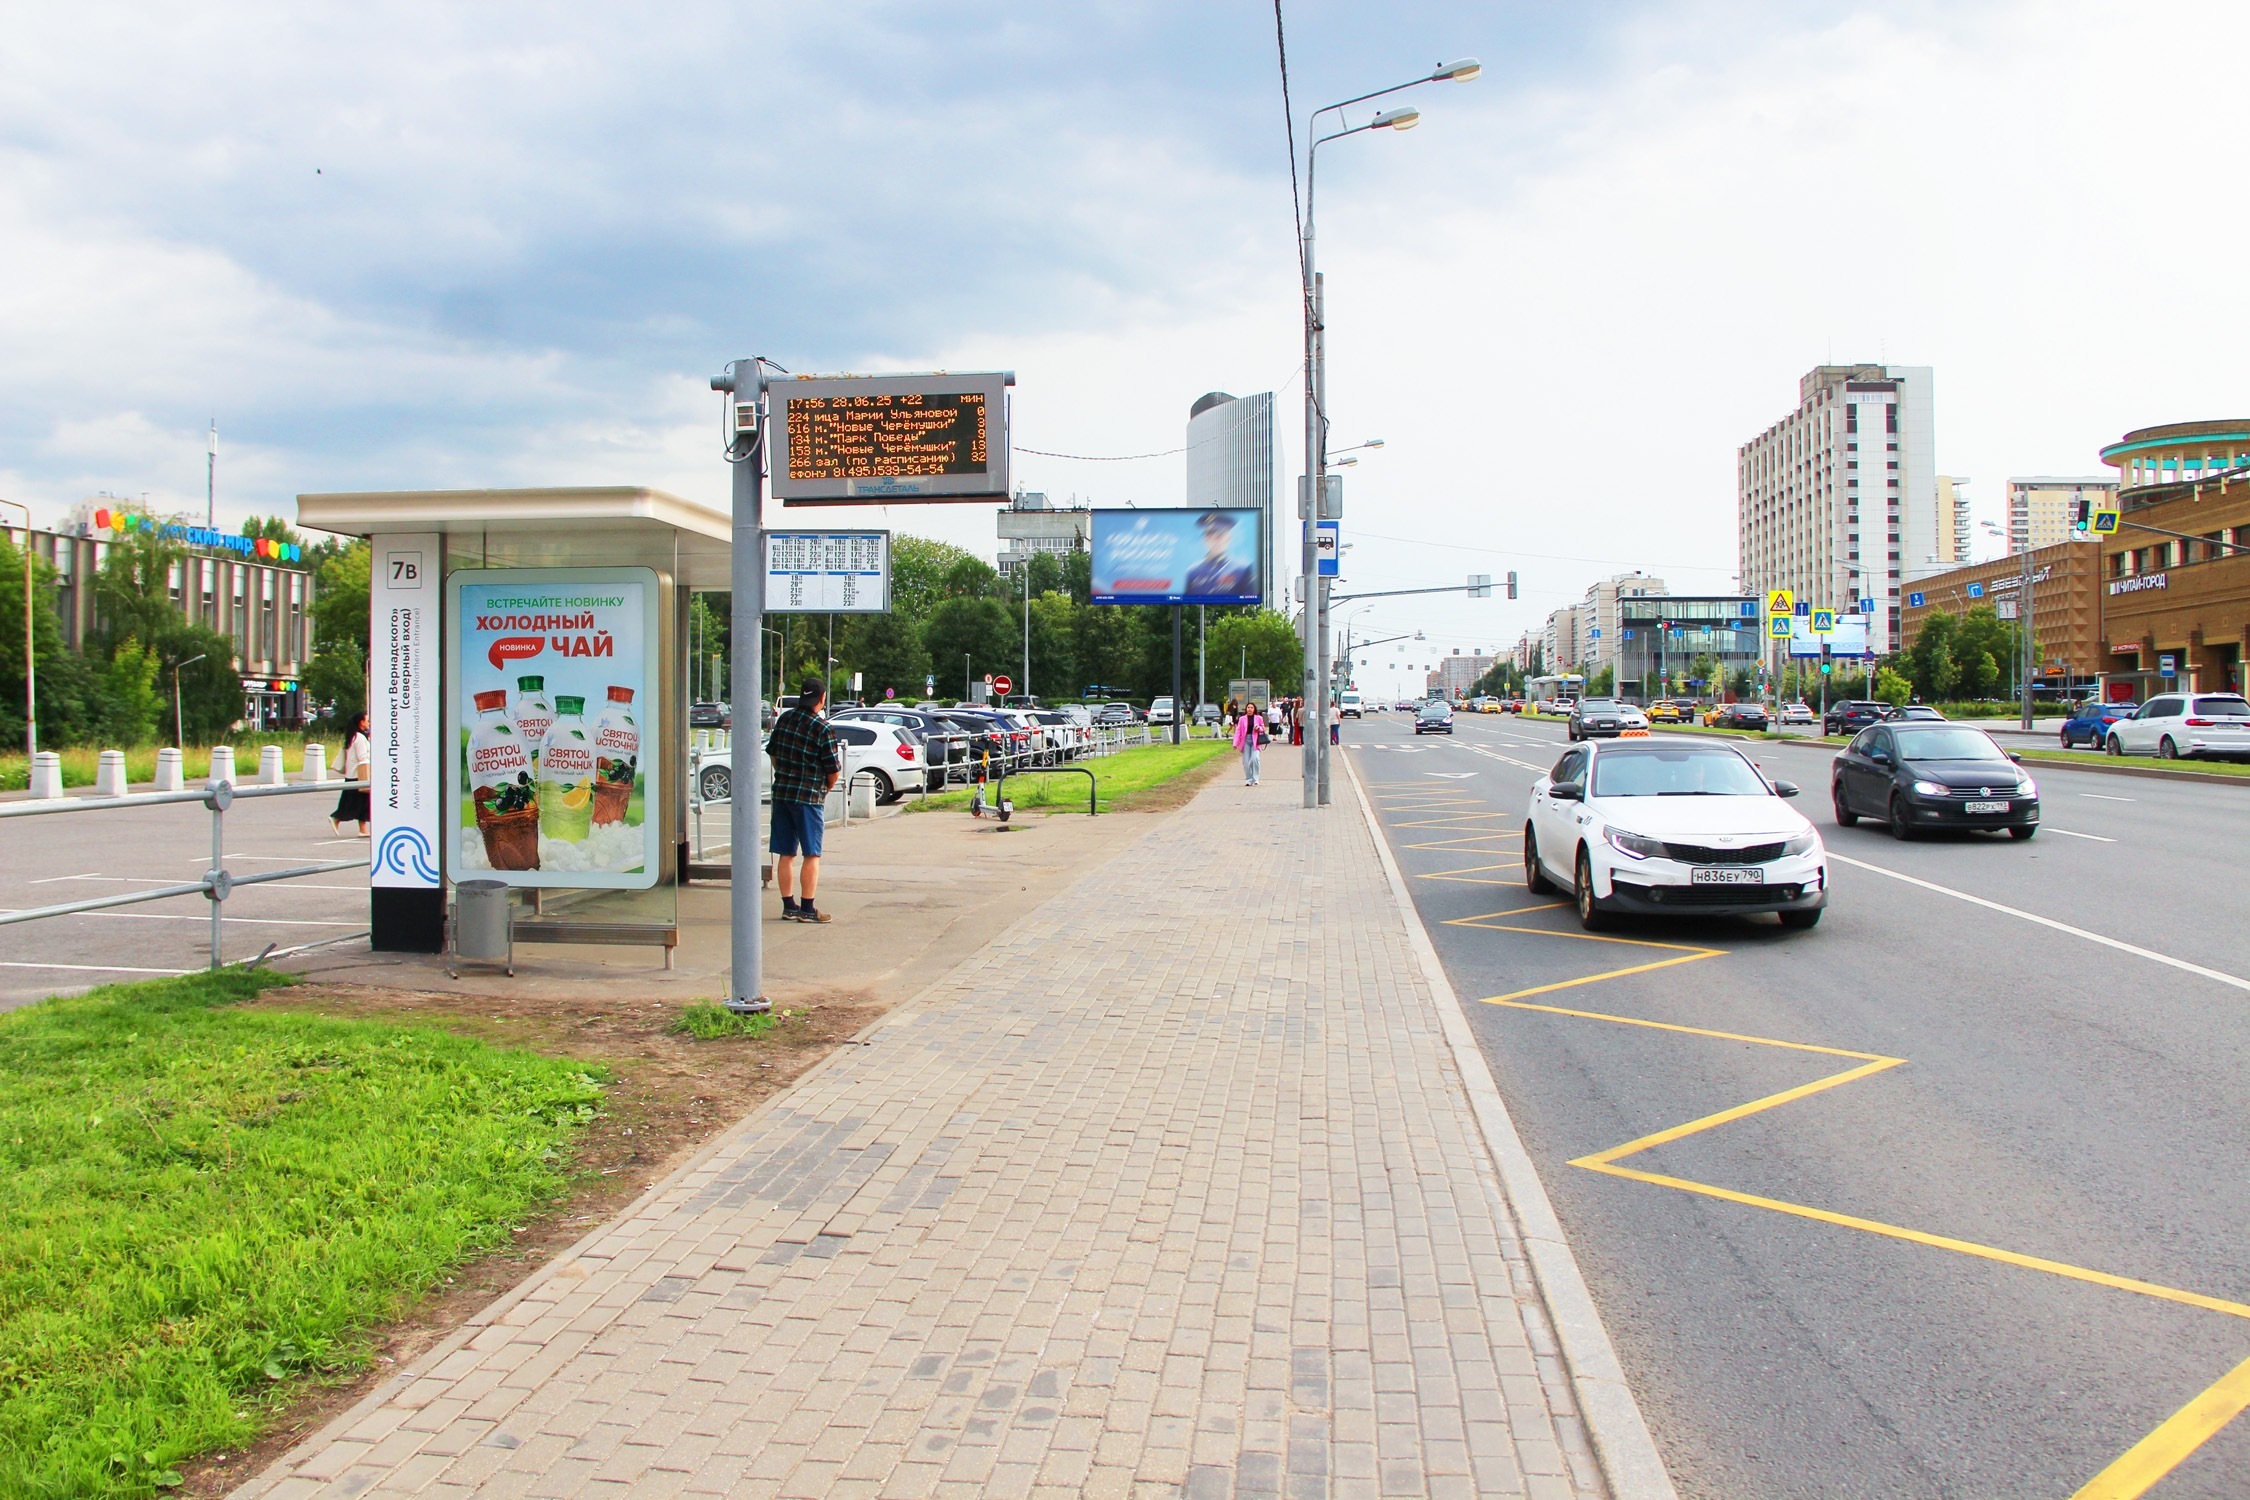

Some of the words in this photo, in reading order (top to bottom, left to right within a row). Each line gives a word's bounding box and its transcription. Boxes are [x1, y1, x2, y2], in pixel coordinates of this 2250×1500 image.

[789, 398, 826, 410] 17:56
[832, 395, 892, 408] 28.06.25
[900, 394, 923, 405] +22
[787, 412, 810, 423] 224
[846, 410, 884, 421] Марии
[890, 408, 958, 419] Ульяновой
[976, 406, 985, 417] 0
[788, 423, 810, 434] 616
[977, 418, 985, 428] 3
[977, 429, 986, 439] 9
[790, 446, 811, 456] 153
[971, 440, 986, 451] 13
[789, 457, 811, 468] 266
[846, 455, 868, 466] (по
[874, 452, 955, 465] расписанию)
[971, 451, 986, 462] 32
[833, 463, 945, 477] 8(495)539-54-54
[857, 484, 919, 494] ТРАНСДЕТАЛЬ
[2120, 573, 2166, 593] ЧИТАЙ-ГОРОД
[486, 596, 562, 609] ВСТРЕЧАЙТЕ
[565, 596, 625, 608] НОВИНКУ
[400, 608, 412, 641] вход)
[412, 607, 421, 646] Entrance)
[476, 610, 594, 632] ХОЛОДНЫЙ
[388, 608, 400, 694] Вернадского»
[551, 629, 613, 657] ЧАЙ
[400, 644, 412, 709] (северный
[413, 648, 421, 688] (Northern
[413, 690, 422, 744] Vernadskogo
[388, 697, 400, 764] «Проспект
[413, 744, 421, 782] Prospekt
[472, 755, 528, 773] ИСТОЧНИК
[543, 758, 594, 770] ИСТОЧНИК
[389, 767, 400, 809] Метро
[413, 783, 421, 810] Metro
[1696, 870, 1740, 882] Н836ЕУ
[1742, 870, 1759, 879] 790
